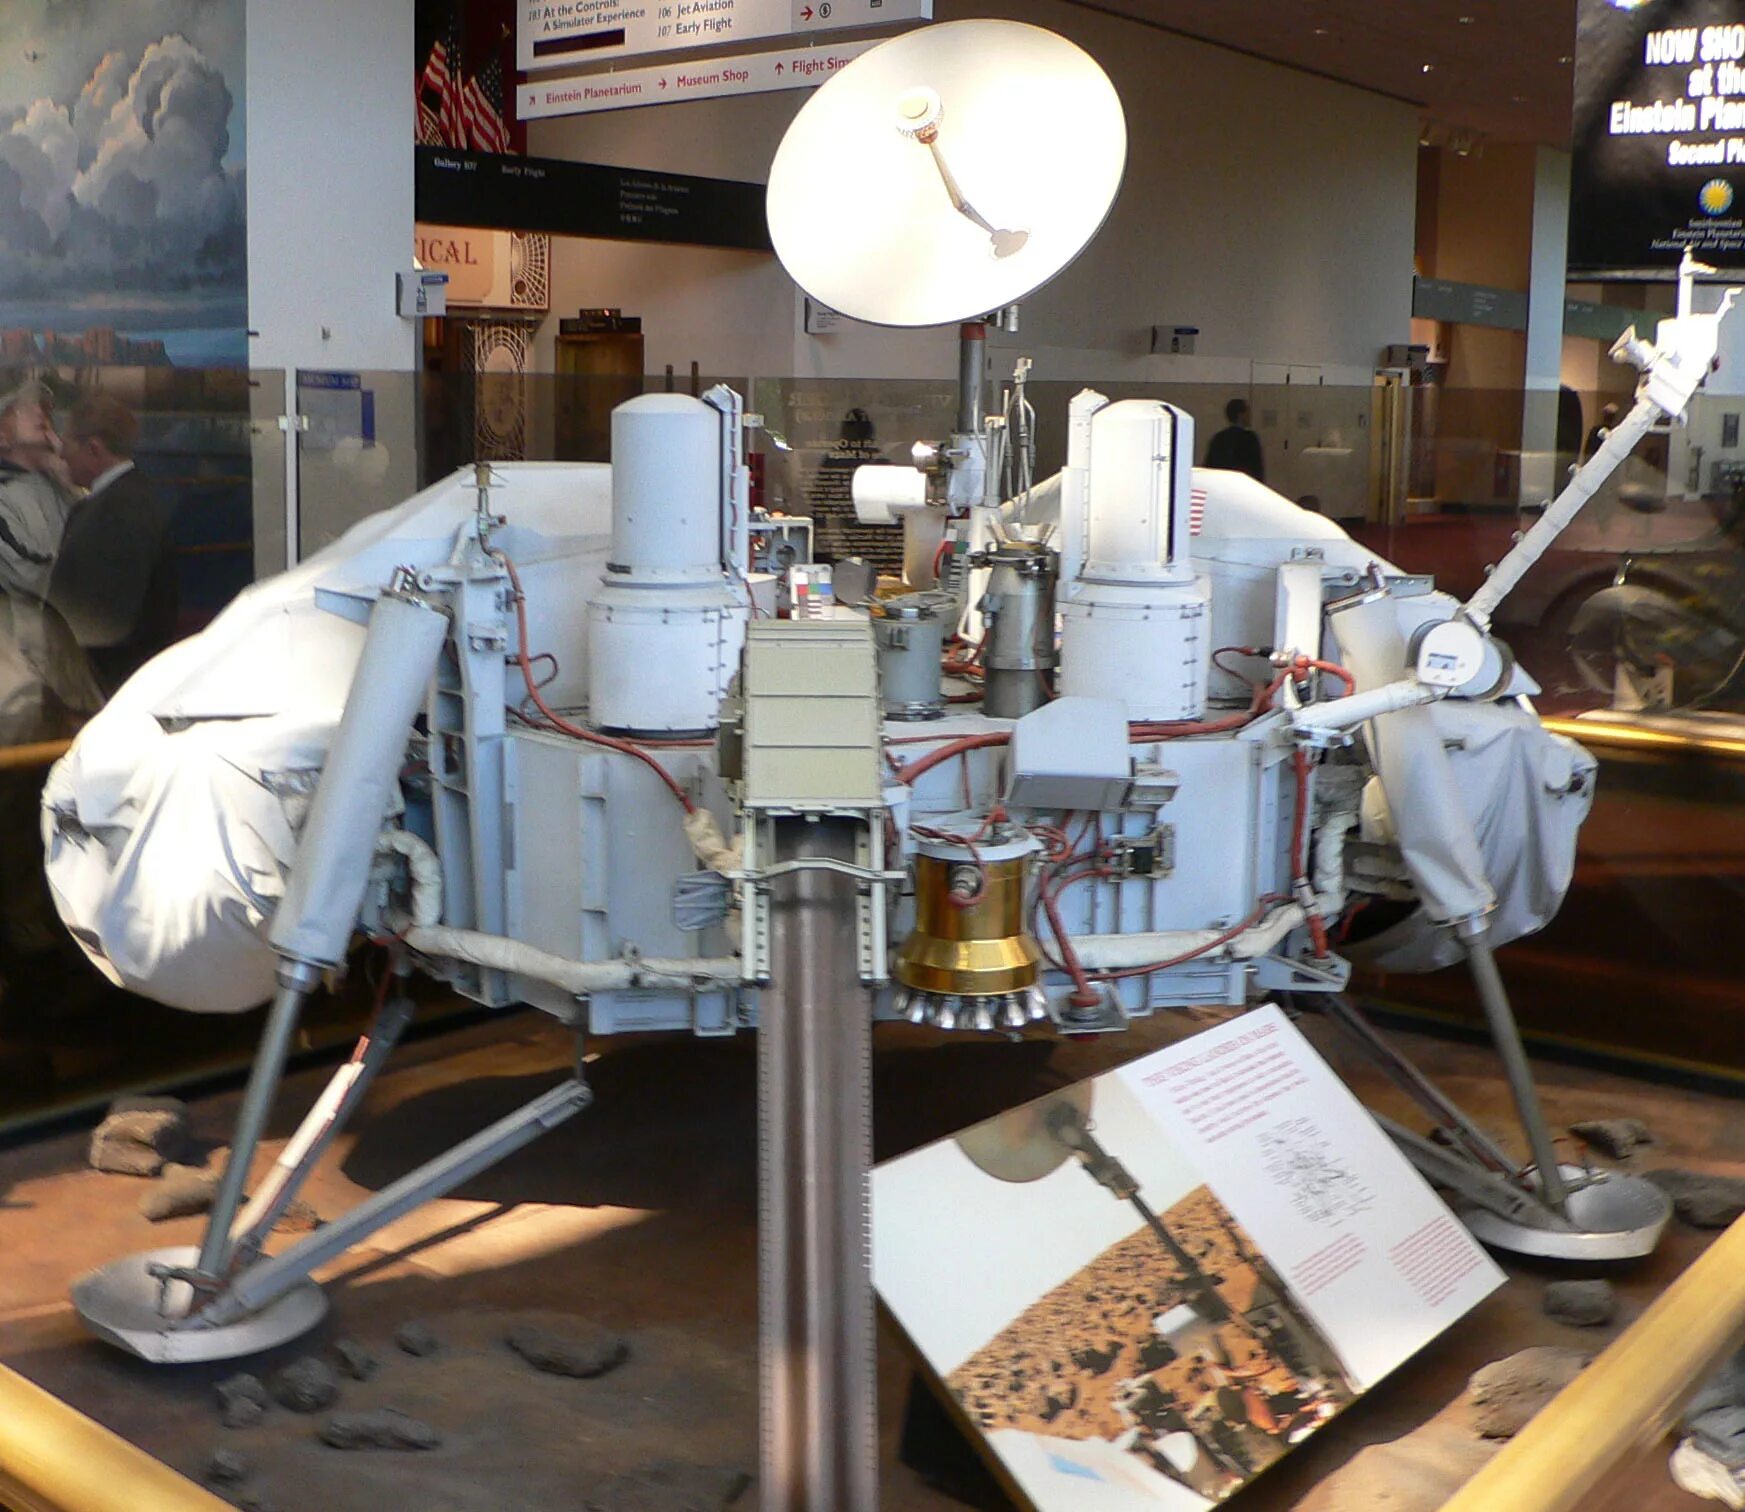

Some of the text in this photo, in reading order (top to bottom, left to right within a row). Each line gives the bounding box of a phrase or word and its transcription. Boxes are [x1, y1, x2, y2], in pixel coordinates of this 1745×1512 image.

[543, 9, 646, 31] A Simulator Experience
[544, 6, 556, 19] At
[557, 4, 573, 17] the
[658, 0, 734, 19] 106 Jet Aviation
[658, 17, 733, 37] 107 Early Flight
[1644, 28, 1698, 65] NOW
[792, 58, 825, 75] Flight
[677, 69, 749, 88] Museum Shop
[1688, 62, 1713, 97] at
[546, 82, 642, 104] Einstein Planetarium
[1609, 97, 1696, 134] Einstein
[1667, 139, 1725, 166] Second
[434, 157, 461, 171] Gallery
[414, 238, 479, 265] ICAL
